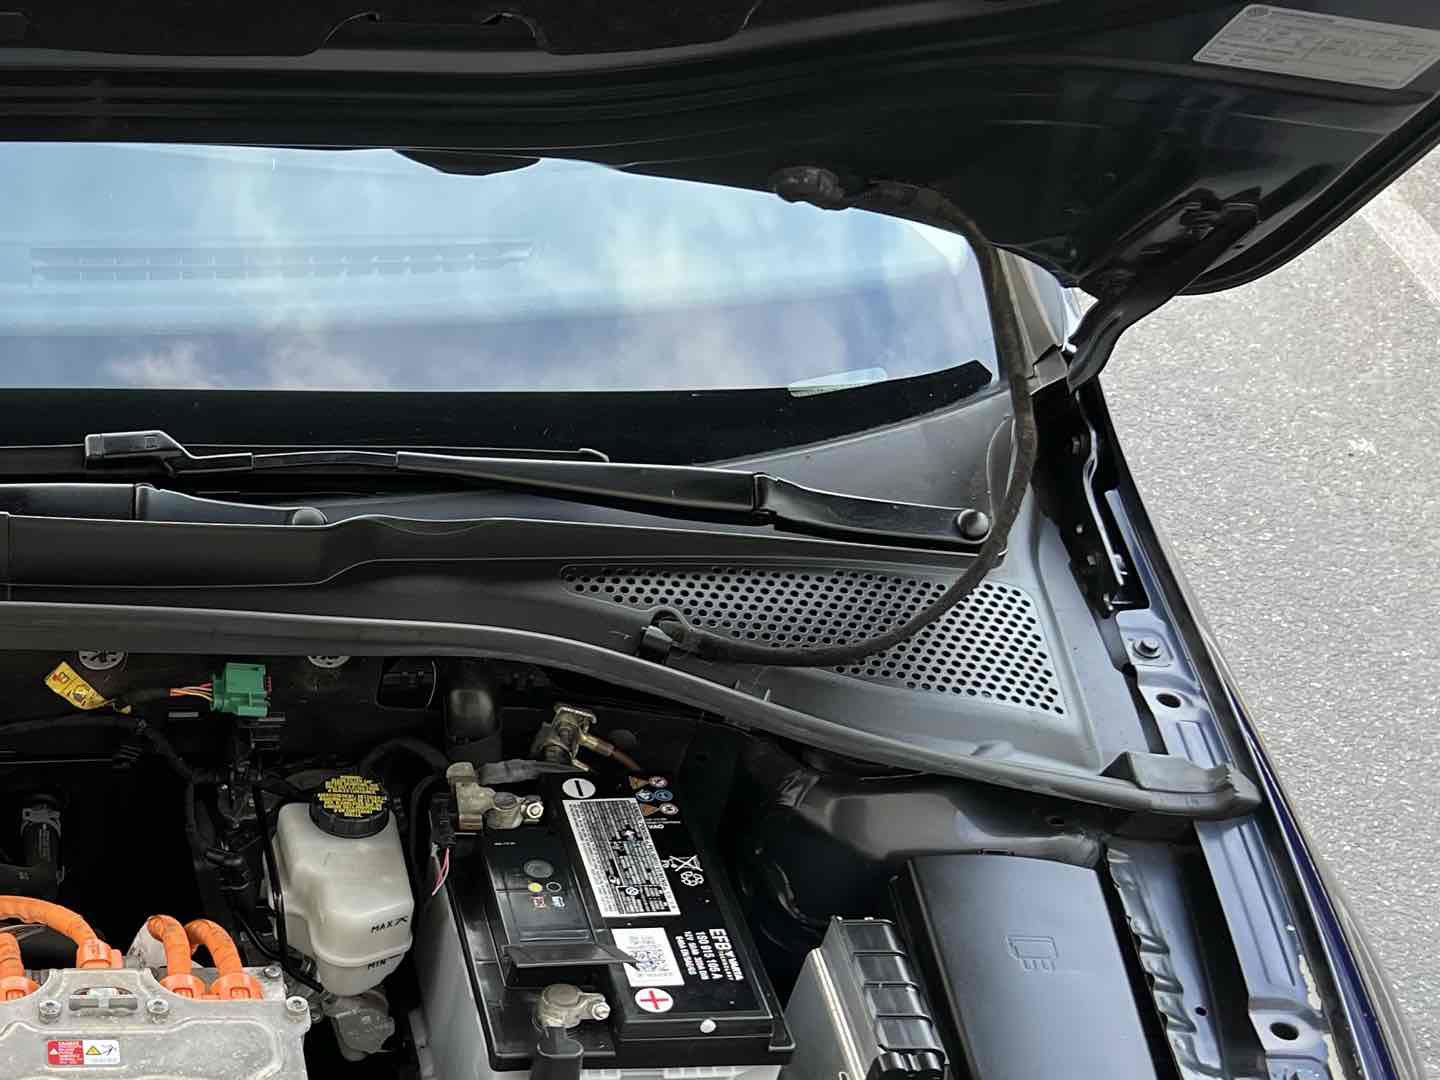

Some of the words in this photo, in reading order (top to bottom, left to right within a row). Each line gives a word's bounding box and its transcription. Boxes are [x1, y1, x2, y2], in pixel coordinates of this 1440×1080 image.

[371, 918, 393, 933] MAX
[709, 928, 733, 951] EFB
[368, 958, 386, 969] MIN
